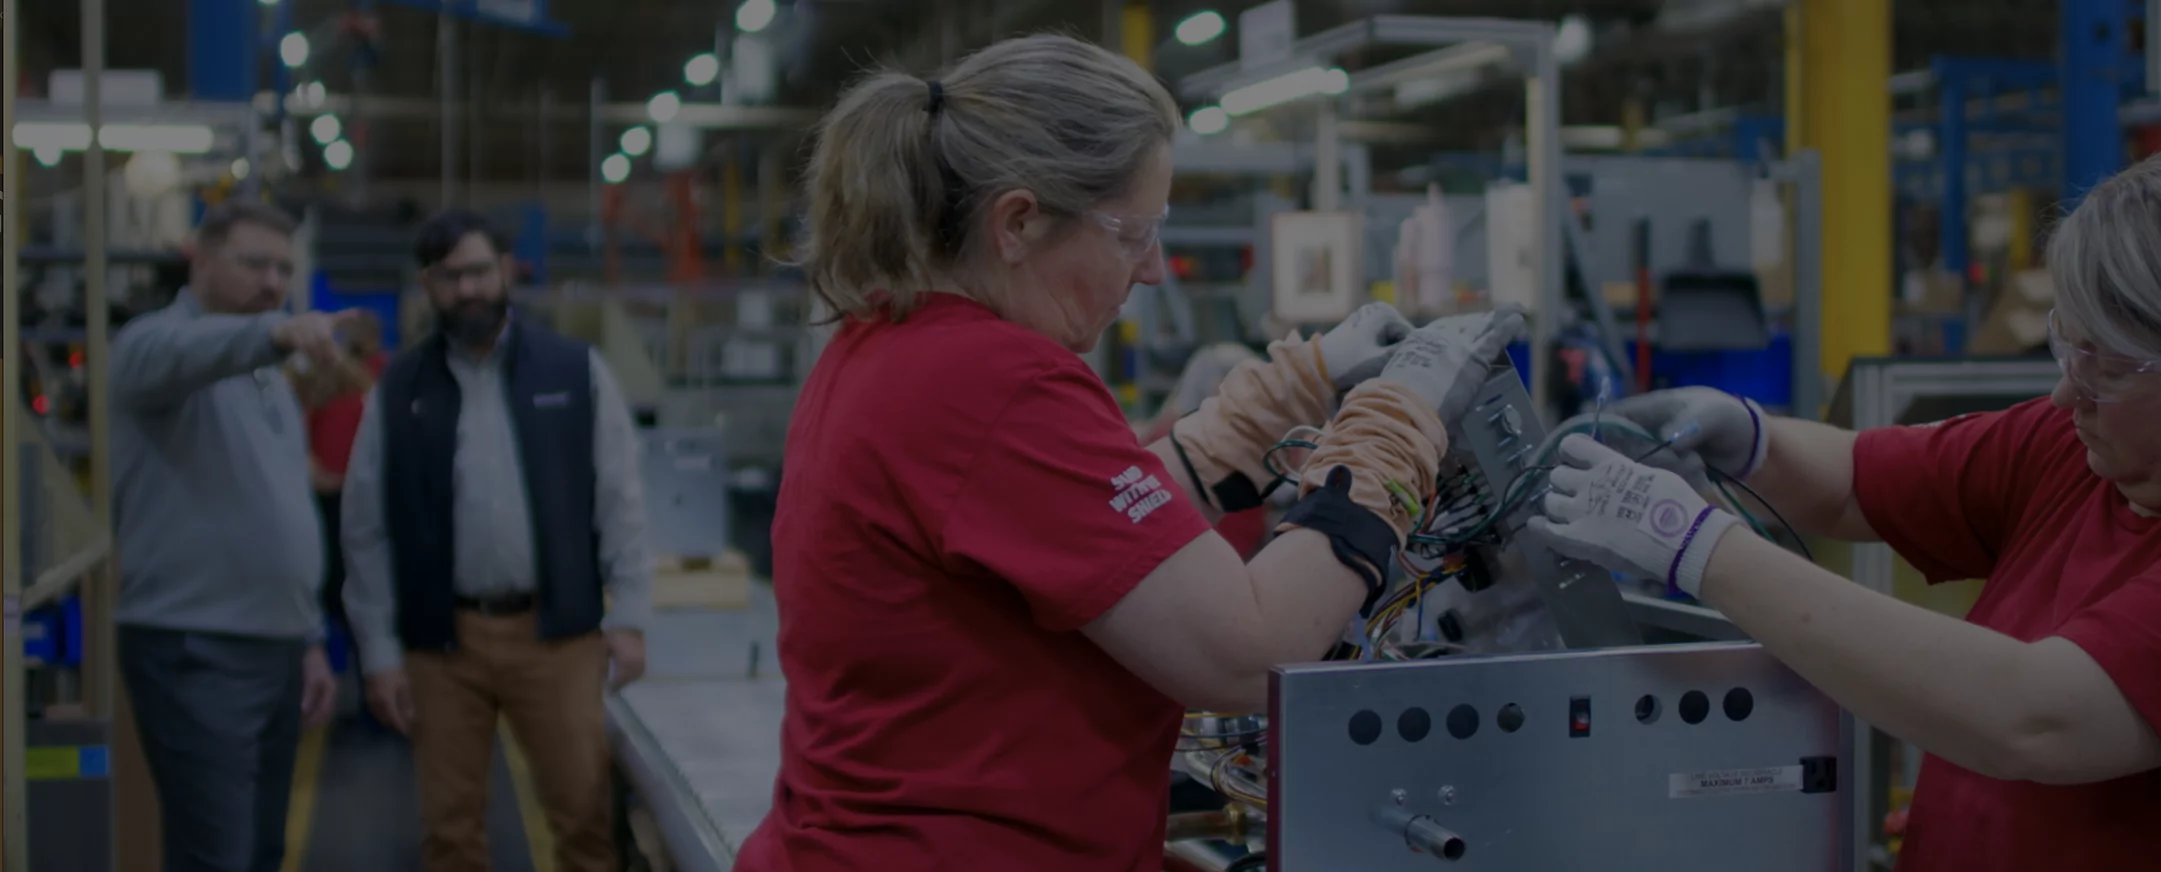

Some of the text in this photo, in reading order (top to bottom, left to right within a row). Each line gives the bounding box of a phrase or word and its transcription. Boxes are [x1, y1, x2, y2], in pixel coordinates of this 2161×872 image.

[1128, 489, 1172, 524] SHIELD
[1700, 778, 1742, 788] MAXIMUM
[1750, 775, 1774, 785] AMPS
